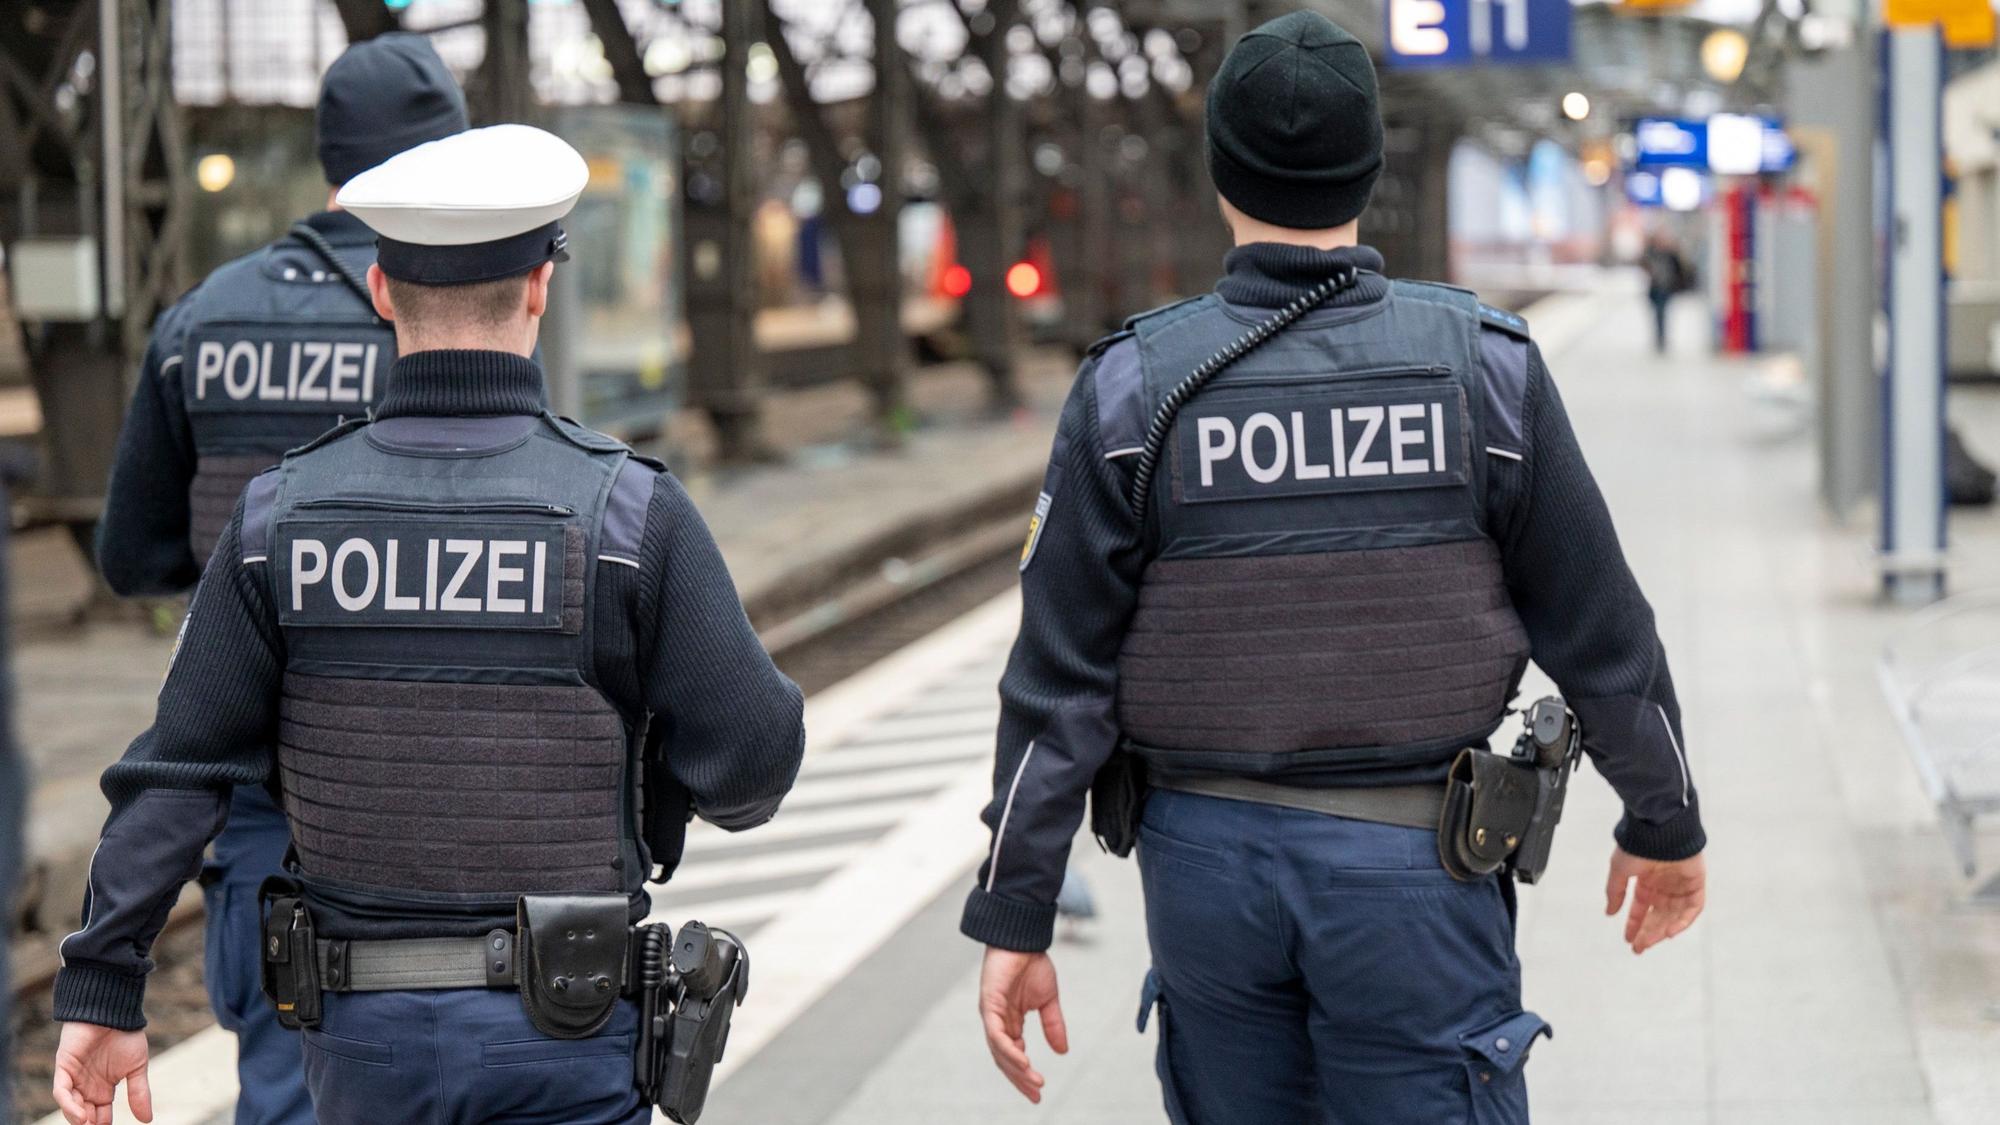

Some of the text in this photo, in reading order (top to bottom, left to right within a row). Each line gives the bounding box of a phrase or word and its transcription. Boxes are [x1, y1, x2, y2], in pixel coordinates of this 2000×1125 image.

[196, 340, 379, 403] POLIZEI
[1197, 402, 1446, 487] POLIZEI
[291, 537, 547, 613] POLIZEI
